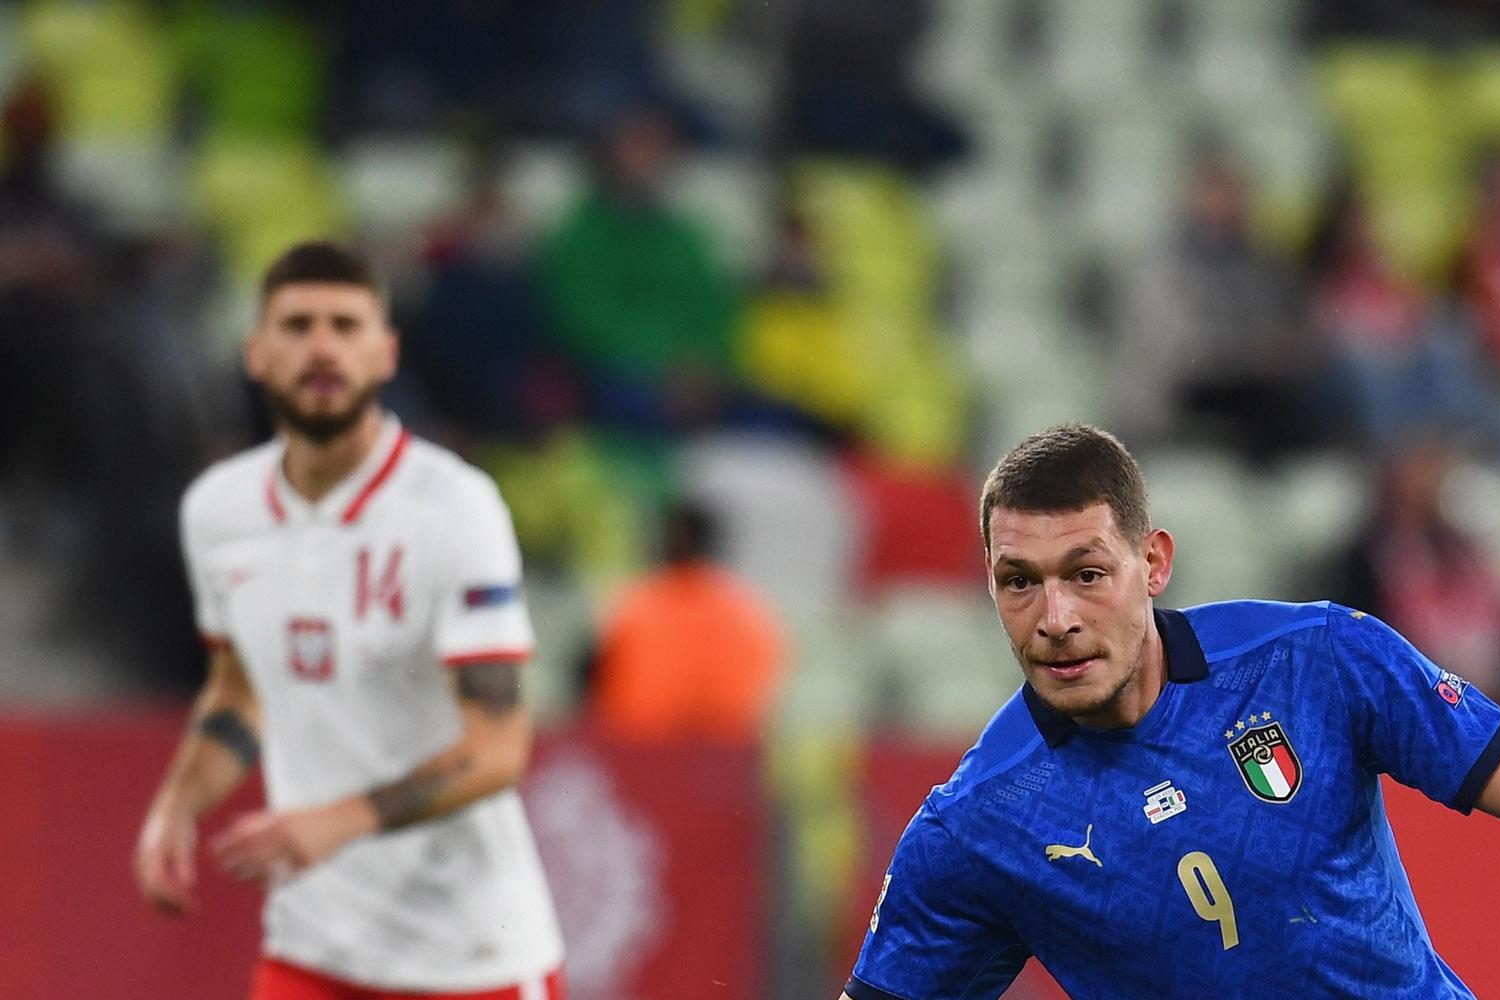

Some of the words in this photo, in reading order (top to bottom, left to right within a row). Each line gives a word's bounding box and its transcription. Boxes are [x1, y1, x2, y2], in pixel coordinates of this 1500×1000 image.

[355, 545, 405, 622] 14
[1235, 729, 1279, 757] ITALIA
[1176, 851, 1239, 950] 9
